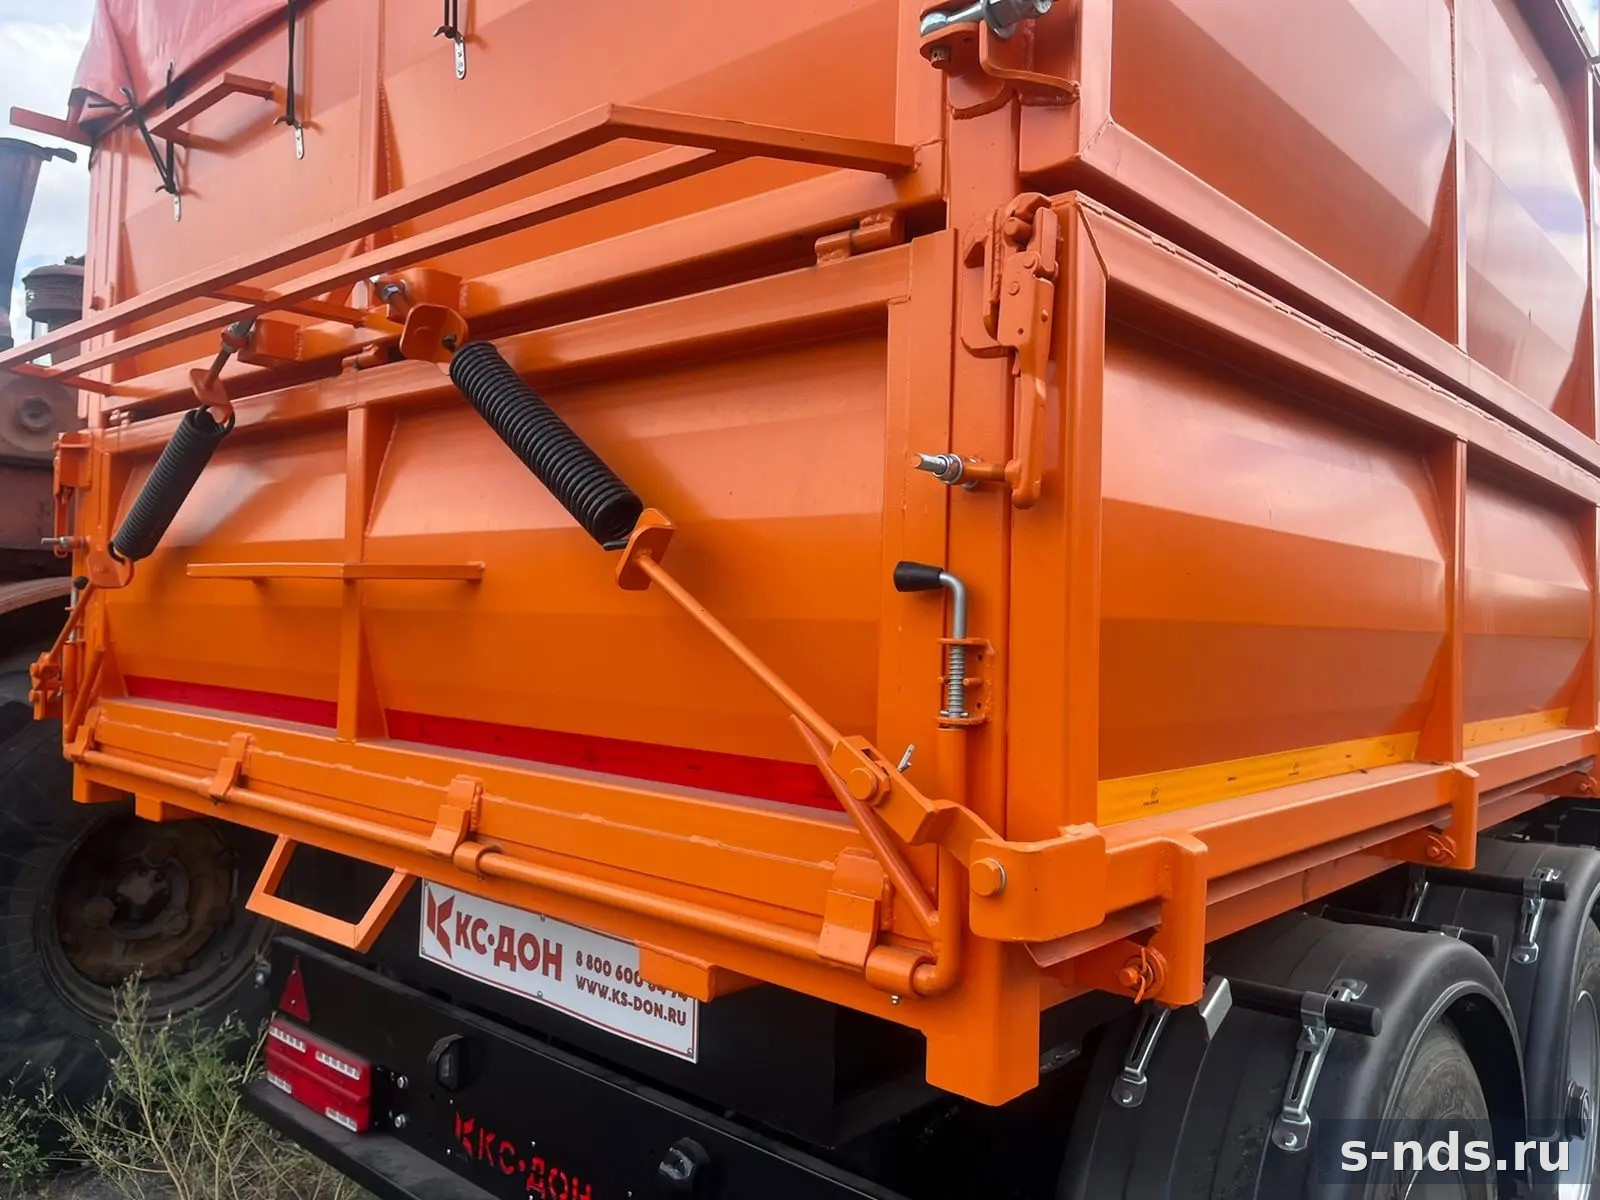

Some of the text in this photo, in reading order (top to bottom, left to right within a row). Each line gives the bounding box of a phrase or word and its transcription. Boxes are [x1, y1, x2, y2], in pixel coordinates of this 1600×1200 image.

[575, 950, 644, 988] 8 800 600
[575, 974, 687, 1027] WWW.KS-DON.RU
